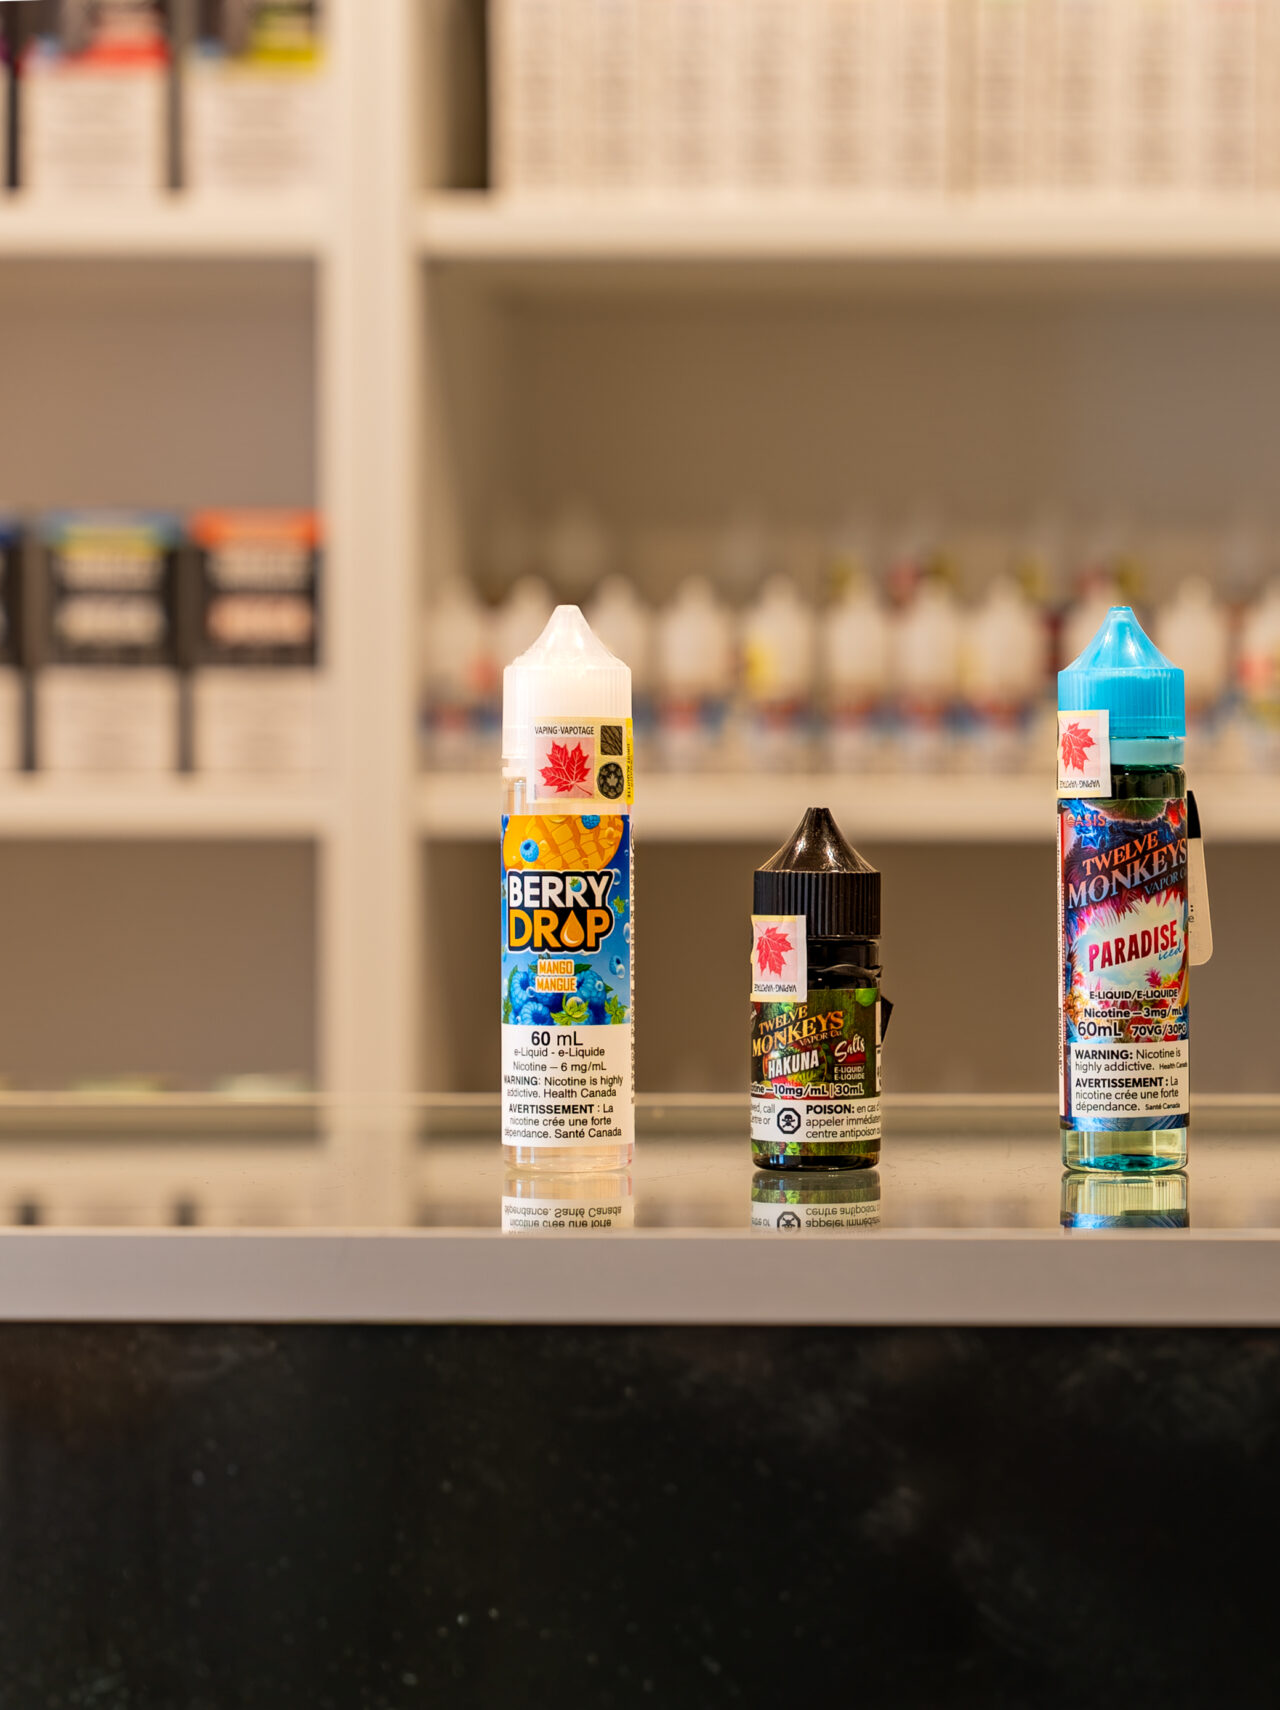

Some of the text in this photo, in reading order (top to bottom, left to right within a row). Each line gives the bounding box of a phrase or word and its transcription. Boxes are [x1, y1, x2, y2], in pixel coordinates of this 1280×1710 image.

[1066, 814, 1106, 828] OASIS
[1083, 830, 1159, 877] TWELVE
[1068, 838, 1187, 909] MONKEYS
[1144, 871, 1179, 895] VAPOR
[508, 875, 610, 908] BERRY
[509, 909, 610, 948] DROP
[1089, 920, 1178, 972] PARADISE
[1158, 939, 1183, 961] iced
[539, 961, 573, 974] MANGO
[536, 978, 576, 991] MANGUE
[1084, 1006, 1182, 1019] Nicotine 3mg/mL
[759, 1006, 808, 1035] TWELVE
[752, 1011, 844, 1057] MONKEYS
[1078, 1022, 1122, 1037] 60mL
[531, 1031, 583, 1046] 60 mL
[800, 1033, 828, 1046] VAPOR
[514, 1047, 605, 1059] e-Liquid e-Liquide
[1075, 1047, 1181, 1060] WARNING: Nicotine is
[513, 1061, 607, 1073] Nicotine 6 mg/mL
[768, 1050, 819, 1079] HAKUNA
[1075, 1062, 1102, 1074] highly
[1104, 1062, 1155, 1072] addictive.
[544, 1077, 587, 1086] Nicotine
[590, 1076, 598, 1085] is
[600, 1075, 623, 1087] highly
[1170, 1076, 1179, 1086] La
[543, 1088, 577, 1098] Health
[580, 1088, 617, 1098] Canada
[774, 1084, 827, 1097] 10mg/mL
[835, 1085, 863, 1095] 30mL
[1076, 1088, 1179, 1100] nicotine crée une forte
[603, 1104, 614, 1113] La
[806, 1104, 855, 1115] POISON:
[857, 1105, 866, 1113] en
[1076, 1101, 1141, 1113] dépendance.
[542, 1117, 565, 1126] crée
[569, 1118, 588, 1126] une
[591, 1116, 612, 1125] forte
[805, 1117, 844, 1129] appeler
[554, 1128, 585, 1138] Santé
[588, 1127, 622, 1137] Canada
[806, 1129, 838, 1139] centre
